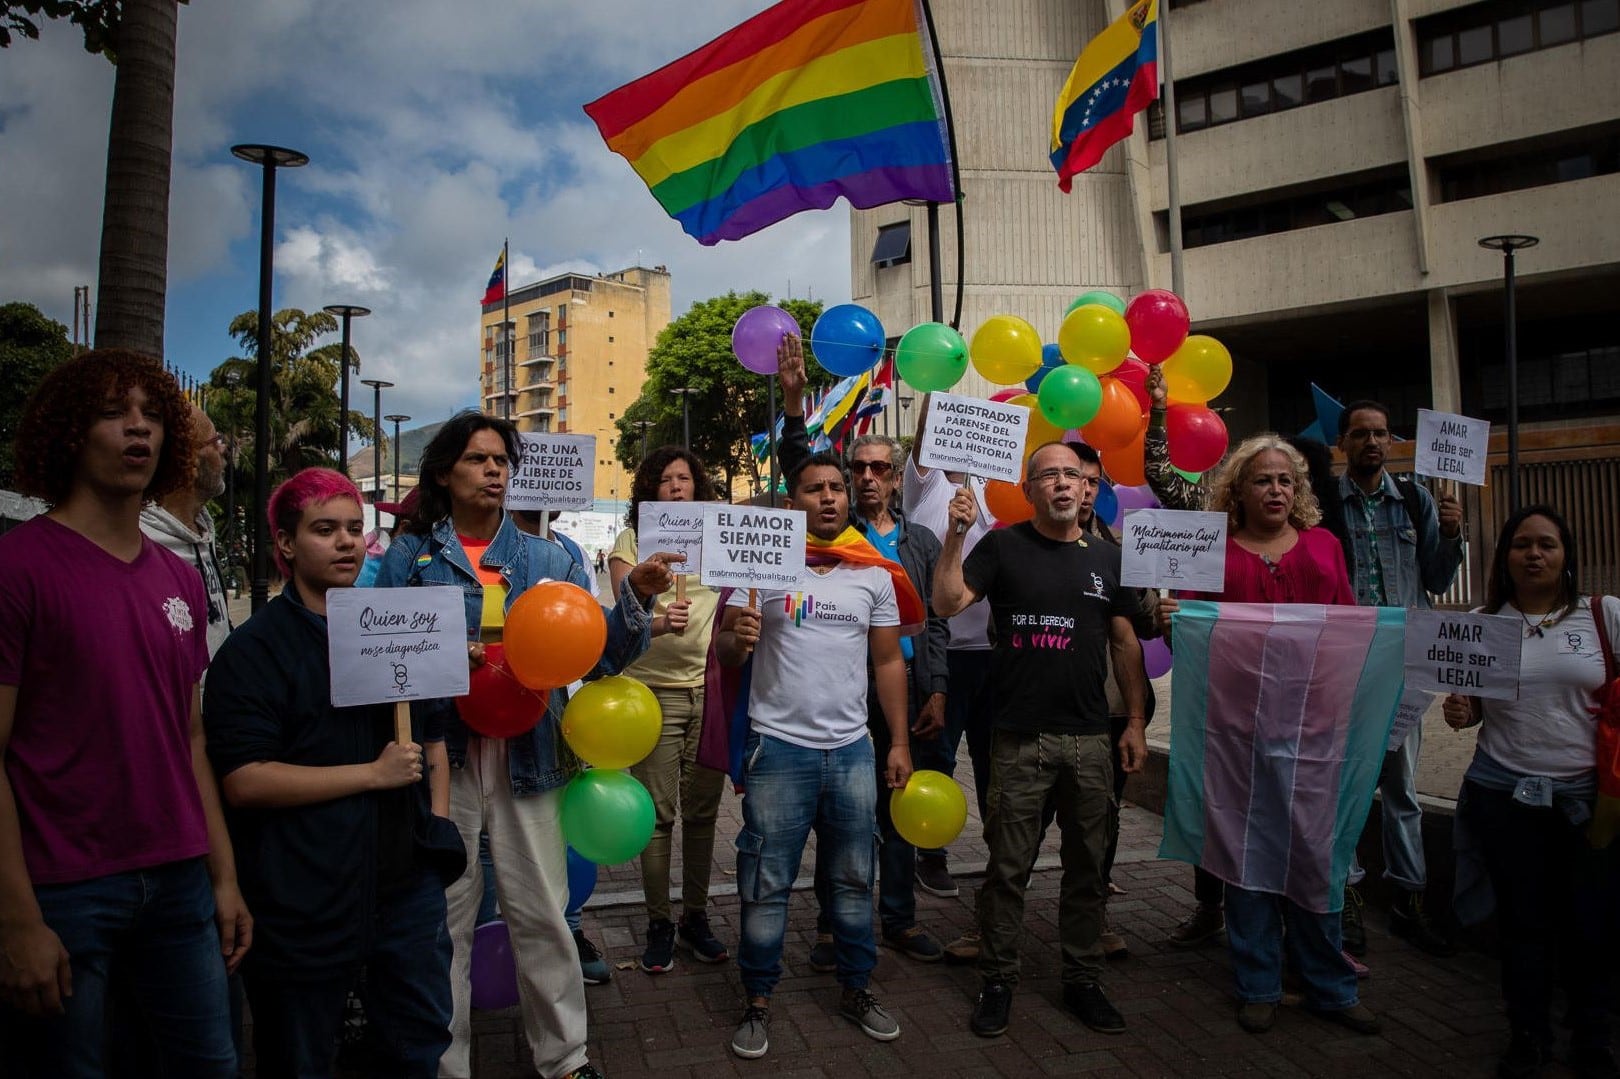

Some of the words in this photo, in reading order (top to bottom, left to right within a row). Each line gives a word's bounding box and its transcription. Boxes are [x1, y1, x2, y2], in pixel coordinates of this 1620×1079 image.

[936, 401, 1021, 425] MAGISTRADXS
[933, 426, 962, 437] LADO
[966, 431, 1018, 449] CORRECTO
[992, 425, 1010, 436] DEL
[1440, 420, 1468, 440] AMAR
[520, 443, 547, 454] POR
[552, 445, 578, 455] UNA
[935, 438, 947, 447] DE
[950, 441, 962, 449] LA
[965, 442, 1012, 460] HISTORIA
[1431, 438, 1457, 454] debe
[1458, 446, 1473, 459] ser
[522, 455, 583, 467] ENEZUELA
[1437, 456, 1465, 475] LEGAL
[523, 467, 556, 478] LIBRE
[559, 469, 573, 478] DE
[512, 479, 582, 491] PREJUICIOS
[659, 513, 690, 528] Quien
[692, 518, 703, 529] so
[717, 513, 734, 526] EL
[740, 515, 793, 531] AMOR
[719, 531, 791, 548] SIEMPRE
[1131, 525, 1193, 541] Matrimonio
[1195, 528, 1219, 542] Civil
[1135, 538, 1191, 555] Igualitario
[1192, 541, 1212, 557] ya!
[727, 549, 782, 565] VENCE
[815, 601, 836, 611] País
[360, 606, 408, 631] Quien
[410, 611, 438, 633] soy
[815, 611, 859, 623] Narrado
[1028, 615, 1038, 625] EL
[1040, 616, 1075, 628] DERECHO
[1438, 622, 1483, 642] AMAR
[1427, 644, 1463, 663] debe
[1468, 653, 1496, 667] ser
[1437, 667, 1484, 688] LEGAL
